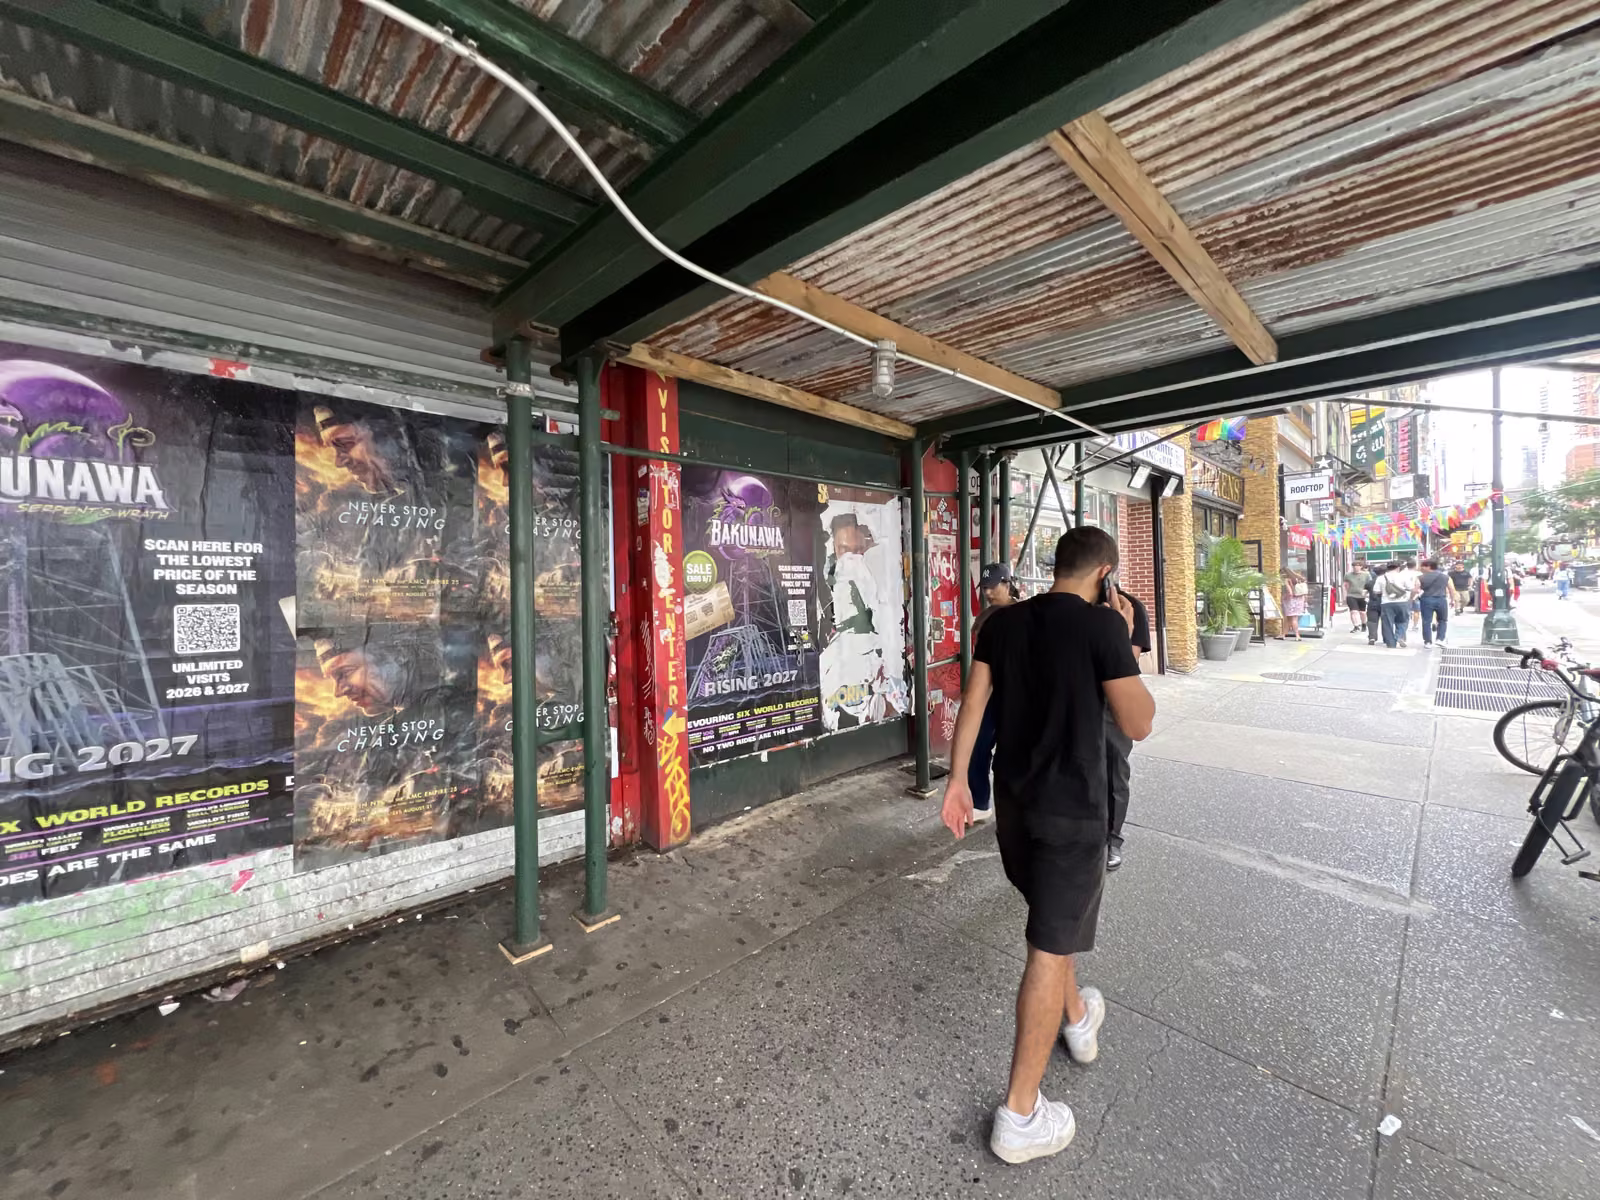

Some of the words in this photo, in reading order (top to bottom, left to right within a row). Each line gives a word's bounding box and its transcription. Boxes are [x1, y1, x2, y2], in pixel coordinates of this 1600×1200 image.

[658, 387, 673, 553] VISITOR
[0, 456, 169, 509] UNAWA
[1290, 483, 1324, 494] ROOFTOP
[16, 503, 113, 517] SERPENT'S
[118, 508, 169, 521] WRATH
[348, 502, 396, 515] NEVER
[403, 505, 437, 518] STOP
[338, 511, 447, 530] CHASING
[552, 518, 578, 528] STOP
[504, 524, 581, 539] CASING
[711, 519, 785, 549] BAKUNAWA
[144, 539, 189, 551] SCAN
[192, 540, 232, 553] HERE
[234, 542, 263, 554] FOR
[157, 554, 189, 566] THE
[192, 555, 253, 567] LOWEST
[154, 568, 202, 580] PRICE
[205, 569, 226, 580] OF
[229, 569, 257, 581] THE
[686, 564, 712, 575] SALE
[176, 583, 237, 595] SEASON
[659, 563, 681, 706] ENTER
[172, 660, 243, 673] UNLIMITED
[187, 673, 230, 684] VISITS
[704, 676, 758, 697] RISING
[764, 670, 798, 687] 2027
[166, 686, 202, 699] 2026
[204, 685, 214, 696] &
[216, 683, 249, 696] 2027
[553, 704, 579, 715] STOP
[688, 713, 735, 729] EVOURING
[737, 710, 750, 719] SIX
[754, 703, 784, 715] WORLD
[785, 697, 819, 709] RECORDS
[347, 722, 396, 738] NEVER
[402, 719, 436, 732] STOP
[504, 712, 585, 732] CSING
[337, 728, 445, 752] CHASING
[703, 745, 715, 754] NO
[716, 741, 735, 750] TWO
[736, 735, 757, 746] RIDES
[759, 732, 772, 741] ARE
[773, 729, 786, 737] THE
[787, 725, 804, 734] SAME
[78, 734, 198, 772] 2027
[424, 788, 449, 797] EMPIRE
[36, 800, 146, 828] WORLD
[156, 780, 269, 808] RECORDS
[404, 805, 425, 813] AUGUST
[103, 822, 144, 833] WORLD'S
[146, 816, 171, 825] FIRST
[187, 816, 225, 827] WORLD'S
[227, 811, 250, 819] FIRST
[103, 821, 170, 838] FLOORLESS
[41, 842, 80, 856] FEET
[47, 857, 99, 877] ARE
[106, 846, 151, 864] THE
[159, 834, 216, 854] SAME
